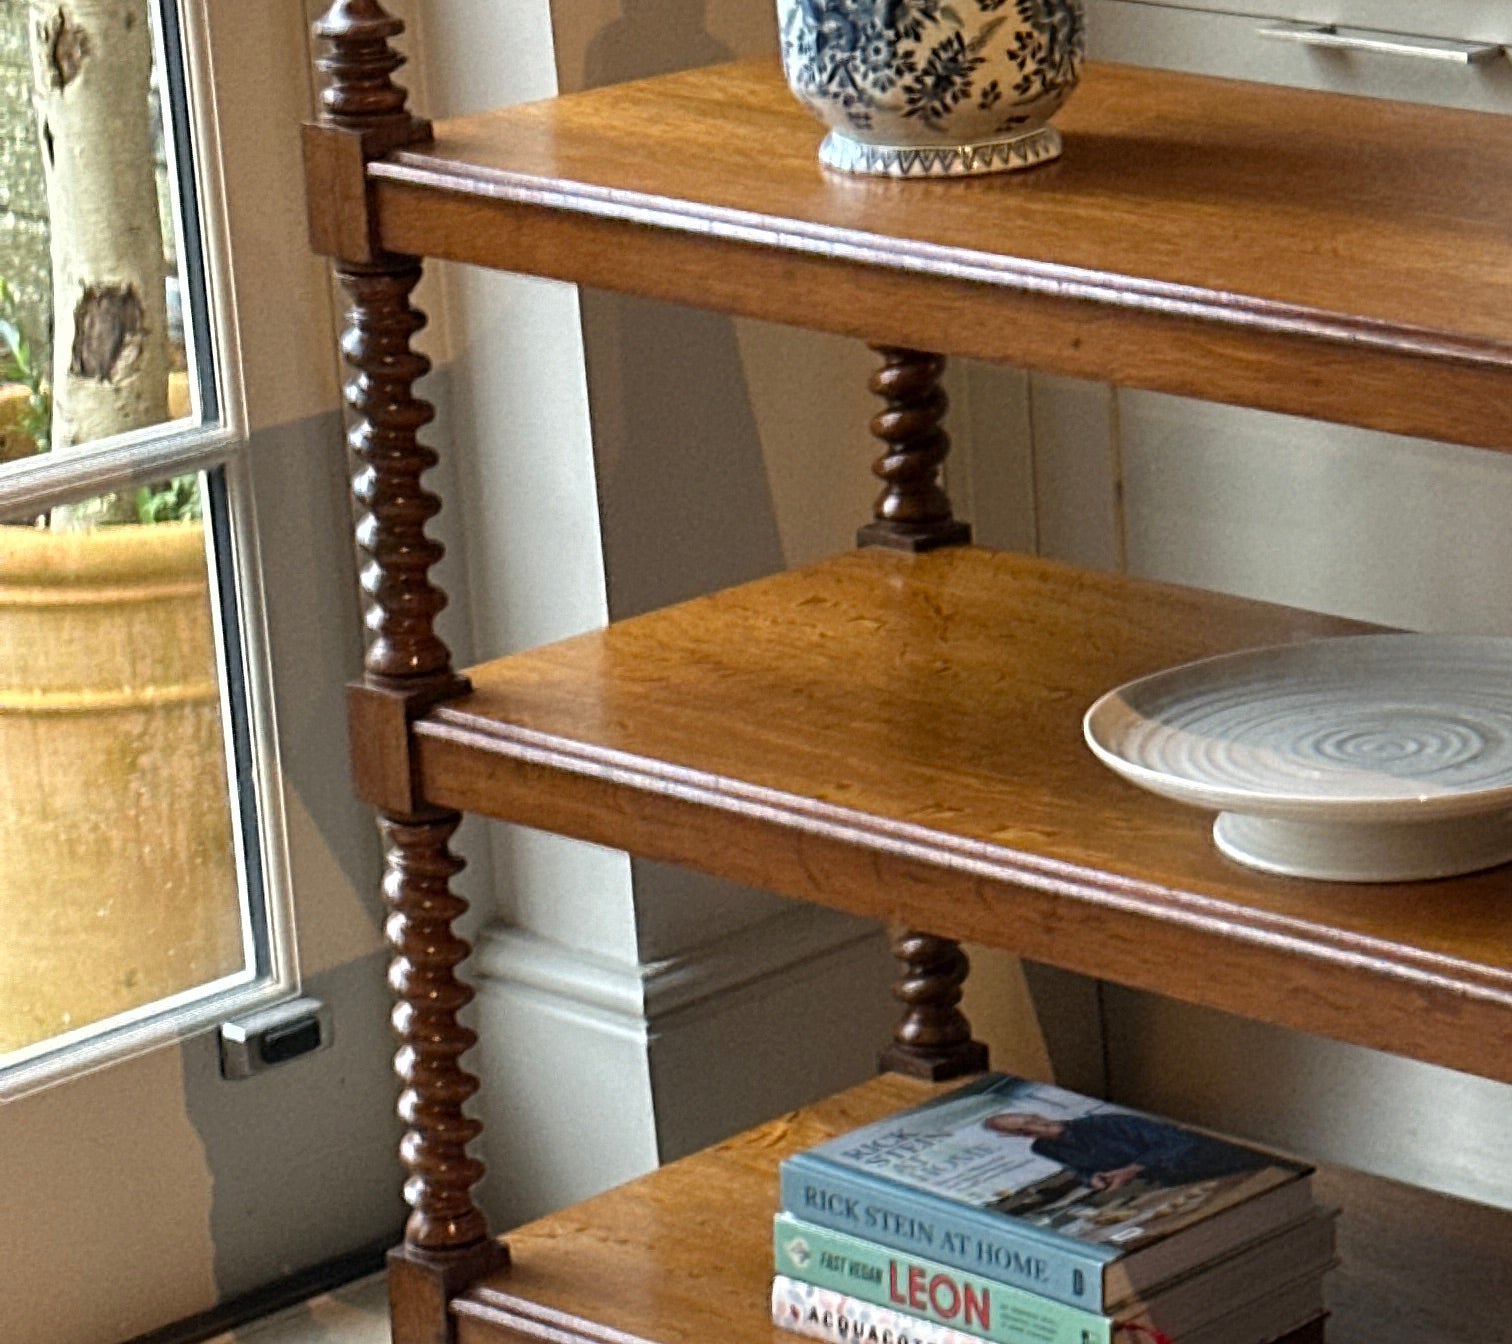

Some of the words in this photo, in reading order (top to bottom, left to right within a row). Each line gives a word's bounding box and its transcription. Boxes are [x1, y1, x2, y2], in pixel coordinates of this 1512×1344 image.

[804, 1185, 859, 1221] RICK
[865, 1206, 935, 1245] STEIN
[941, 1230, 971, 1256] AT
[976, 1239, 1049, 1282] HOME
[889, 1259, 990, 1332] LEON
